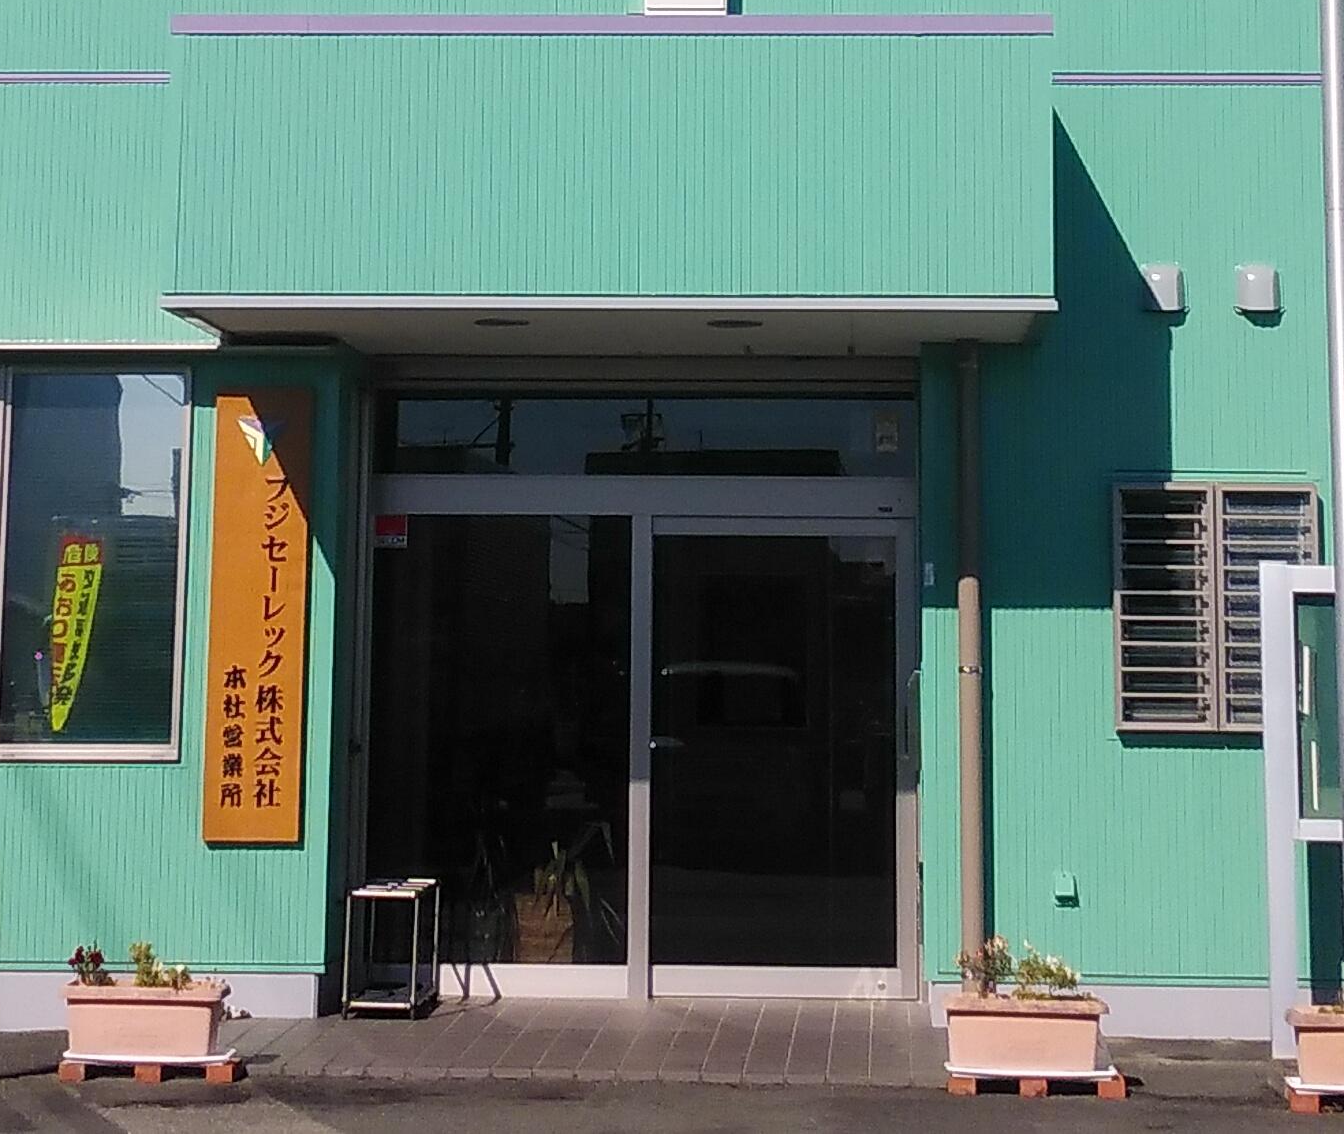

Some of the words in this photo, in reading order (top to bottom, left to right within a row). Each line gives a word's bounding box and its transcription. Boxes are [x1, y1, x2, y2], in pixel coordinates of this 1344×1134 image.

[220, 665, 247, 809] 本社営業所
[253, 477, 290, 809] フジセーレック株式会社
